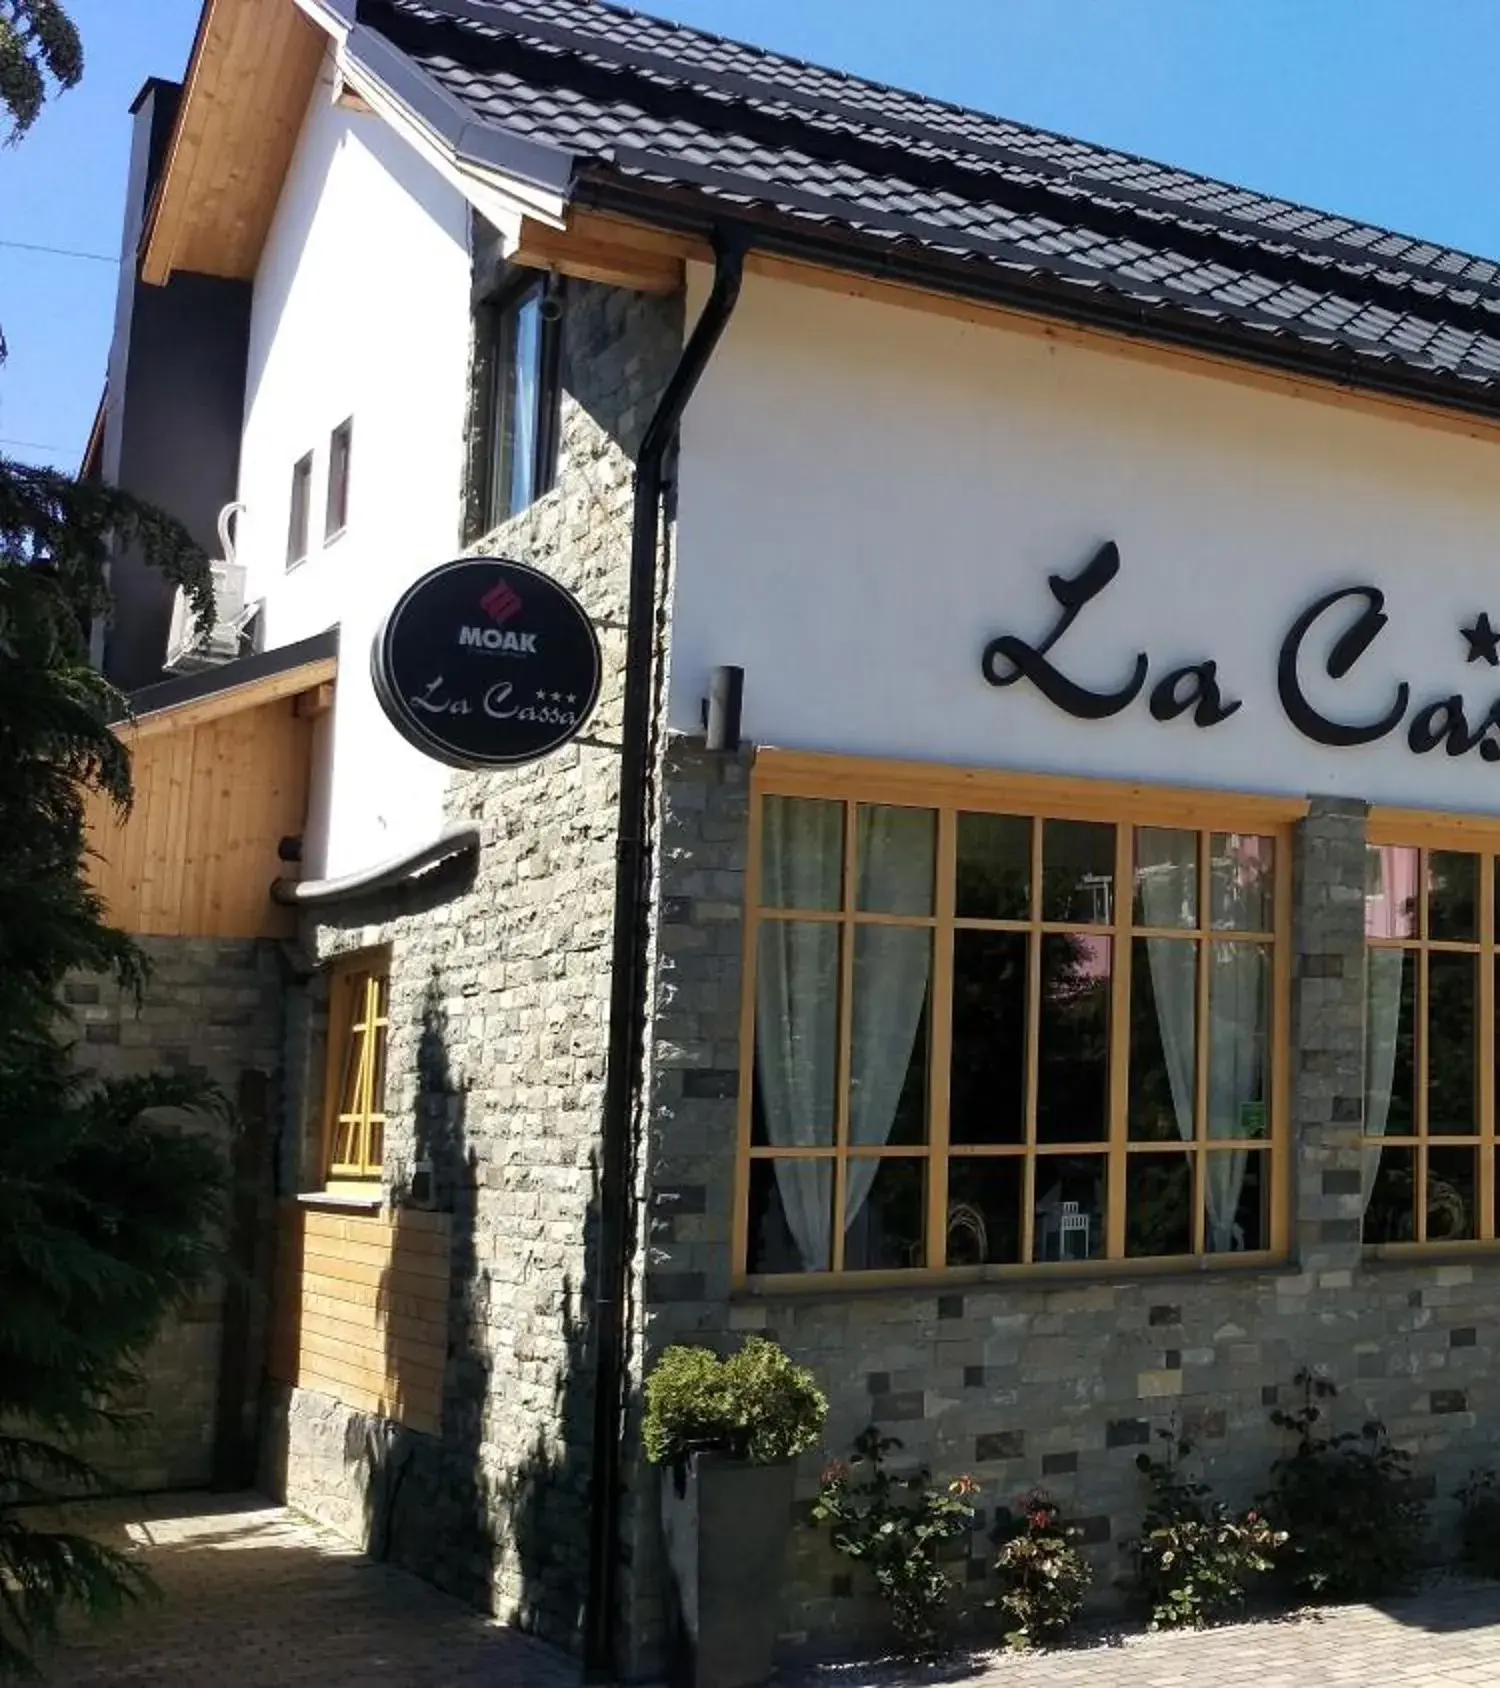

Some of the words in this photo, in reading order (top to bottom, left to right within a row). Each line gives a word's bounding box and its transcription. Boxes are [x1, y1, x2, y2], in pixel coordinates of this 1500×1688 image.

[459, 624, 537, 654] MOAK
[981, 539, 1243, 728] La
[410, 674, 472, 714] La
[483, 681, 576, 726] Cassa
